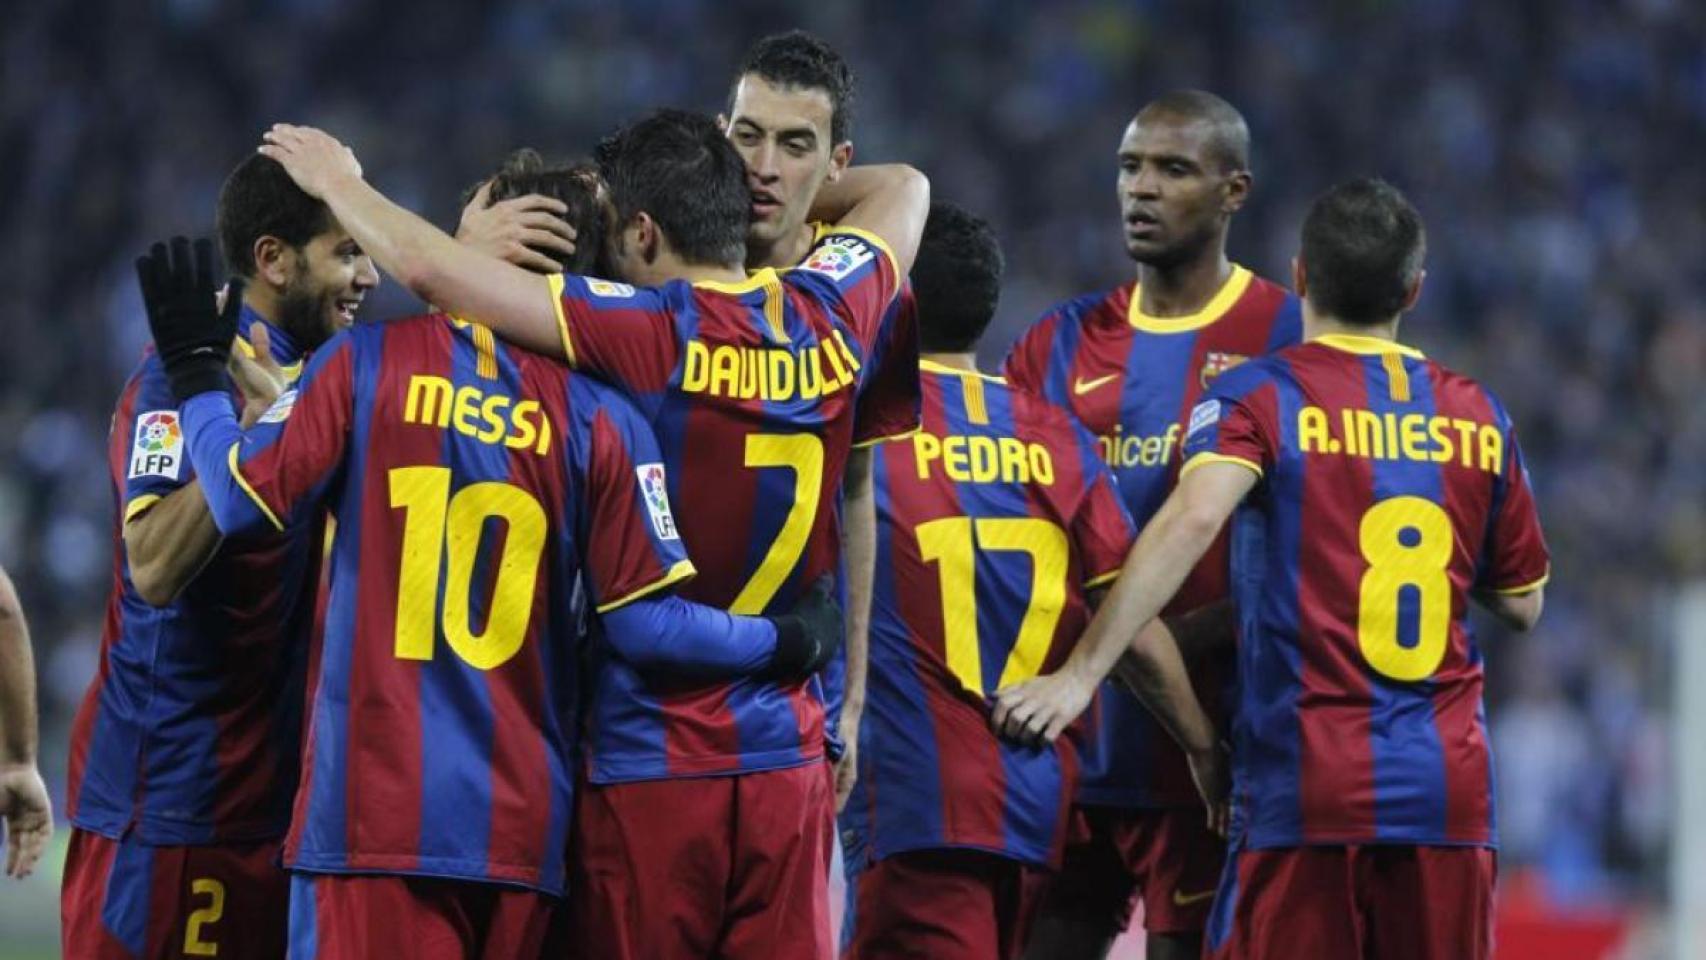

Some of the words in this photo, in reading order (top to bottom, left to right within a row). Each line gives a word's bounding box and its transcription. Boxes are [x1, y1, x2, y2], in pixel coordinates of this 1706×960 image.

[682, 340, 796, 401] DAVID
[405, 375, 551, 456] MESSI
[1098, 423, 1182, 468] nicef
[1297, 406, 1503, 475] A.INIESTA
[134, 454, 173, 475] LFP
[914, 432, 1055, 486] PEDRO
[729, 433, 824, 615] 7
[389, 466, 547, 671] 10
[915, 516, 1069, 698] 17
[1358, 497, 1453, 682] 8
[183, 879, 224, 956] 2
